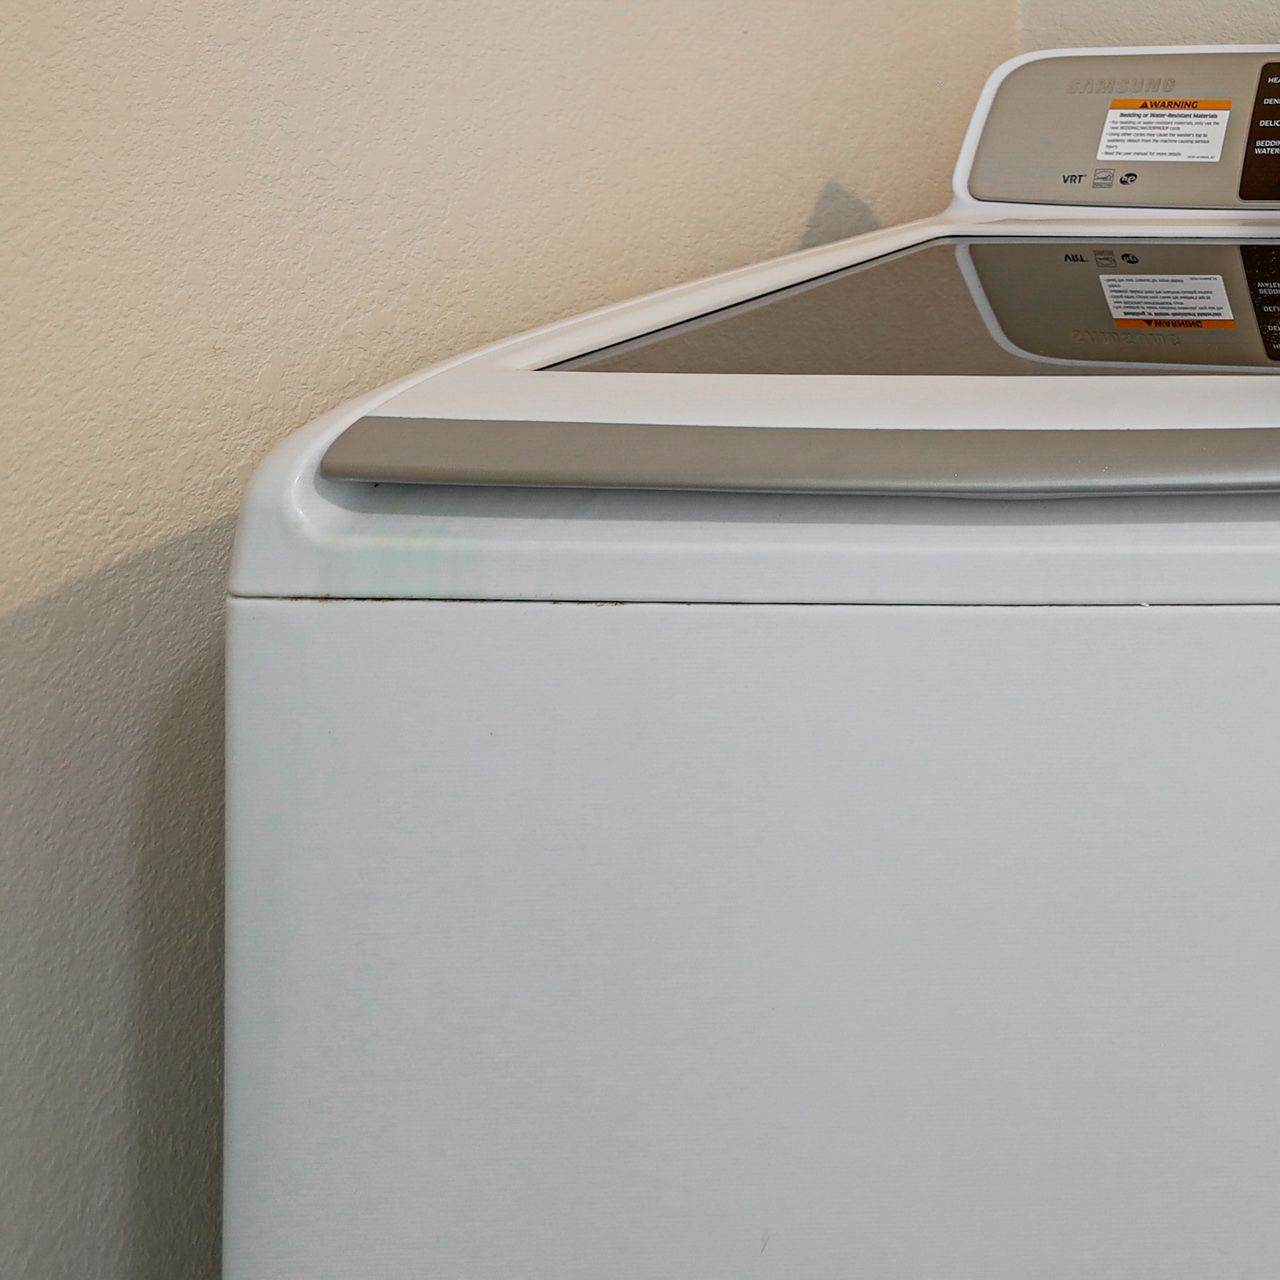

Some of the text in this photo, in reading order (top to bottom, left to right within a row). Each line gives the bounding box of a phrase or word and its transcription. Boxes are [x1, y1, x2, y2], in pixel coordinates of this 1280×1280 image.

[1066, 78, 1176, 94] SAMSUNG
[1150, 101, 1198, 109] WARNING
[1062, 174, 1085, 184] VRT
